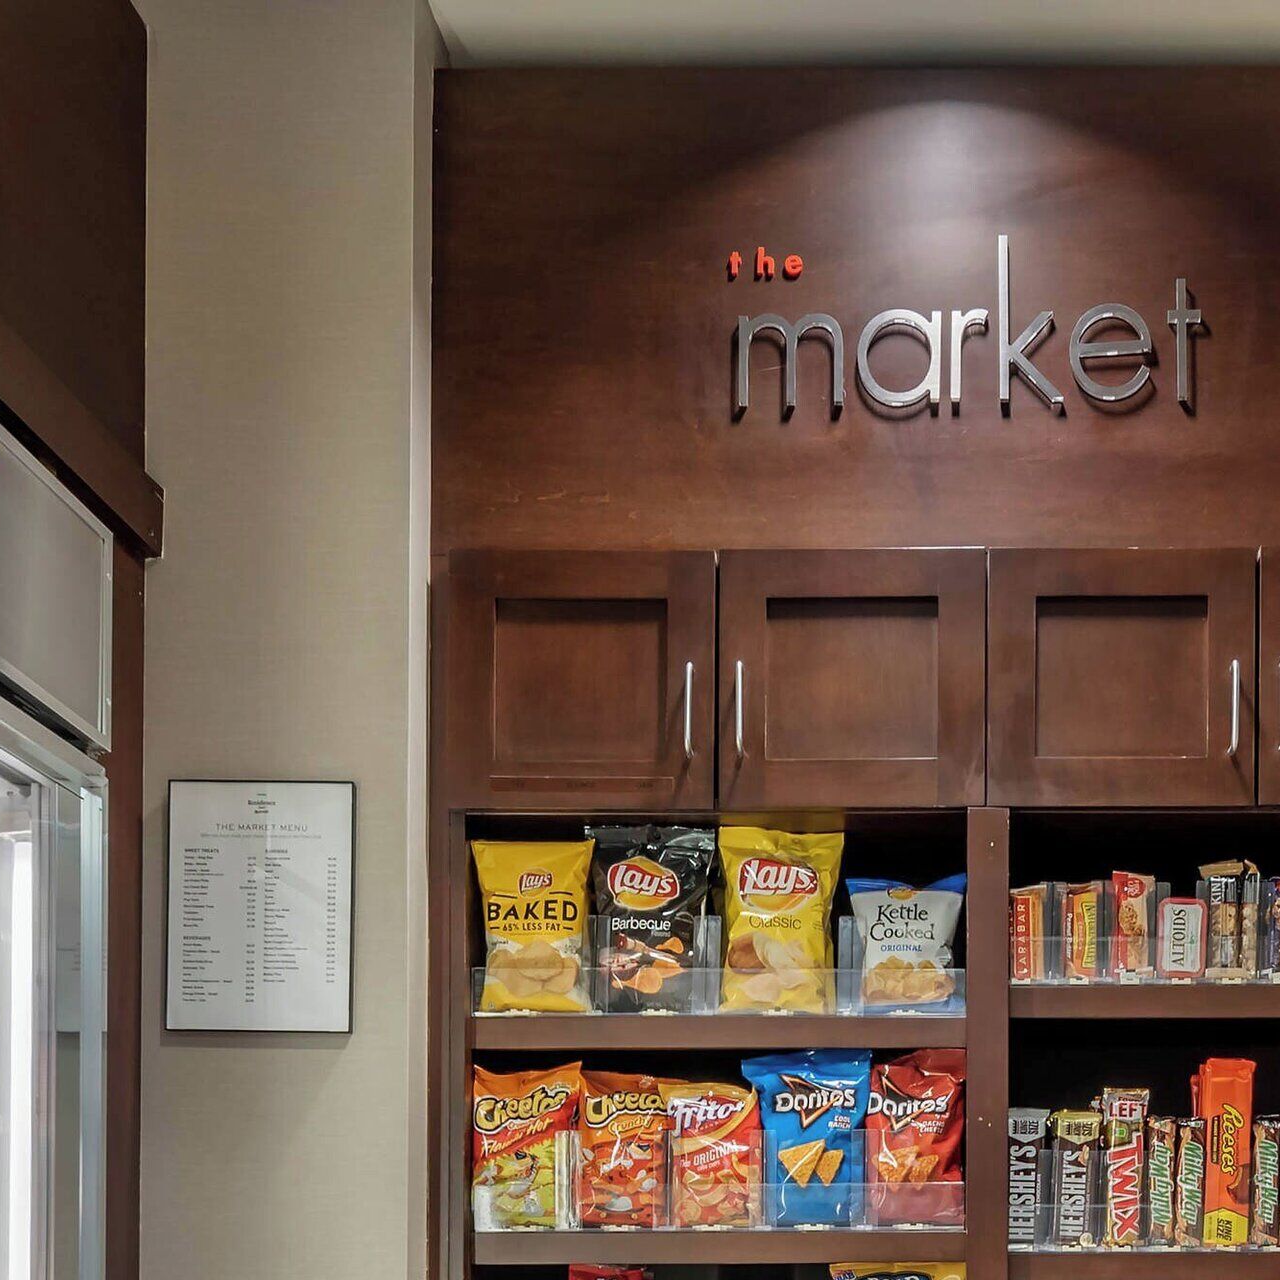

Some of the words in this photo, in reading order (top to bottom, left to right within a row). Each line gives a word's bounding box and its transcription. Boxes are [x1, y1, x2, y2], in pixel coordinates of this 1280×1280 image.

[727, 246, 804, 281] the
[735, 233, 1207, 412] market
[238, 823, 276, 832] MARKET
[280, 823, 308, 832] MENU
[521, 872, 552, 892] Lay's
[612, 865, 675, 897] Lay's
[740, 858, 818, 896] Lay's
[1210, 876, 1222, 905] KIND
[488, 899, 578, 922] BAKED
[748, 914, 802, 930] Classic
[876, 903, 929, 924] Kettle
[522, 922, 542, 932] LESS
[545, 922, 562, 932] FAT
[611, 917, 671, 932] Barbecue
[870, 922, 936, 943] Cooked
[880, 944, 923, 952] ORIGINAL
[1171, 908, 1187, 968] ALTOIDS
[775, 1088, 856, 1118] Doritos
[867, 1092, 949, 1117] Doritos
[1109, 1101, 1147, 1118] LEFT
[528, 1118, 553, 1135] Hot
[828, 1121, 852, 1129] RANCH
[834, 1115, 851, 1123] COOL
[1220, 1103, 1246, 1176] Reese's
[1177, 1141, 1205, 1184] Milky
[1255, 1139, 1280, 1182] Milky
[1008, 1145, 1037, 1240] HERSHEY'S
[1060, 1150, 1087, 1238] HERSHEY'S
[1107, 1132, 1144, 1240] TWIX
[1149, 1178, 1175, 1226] Milky
[1176, 1184, 1202, 1226] Way
[1216, 1217, 1224, 1241] SIZE
[1224, 1220, 1233, 1242] KING
